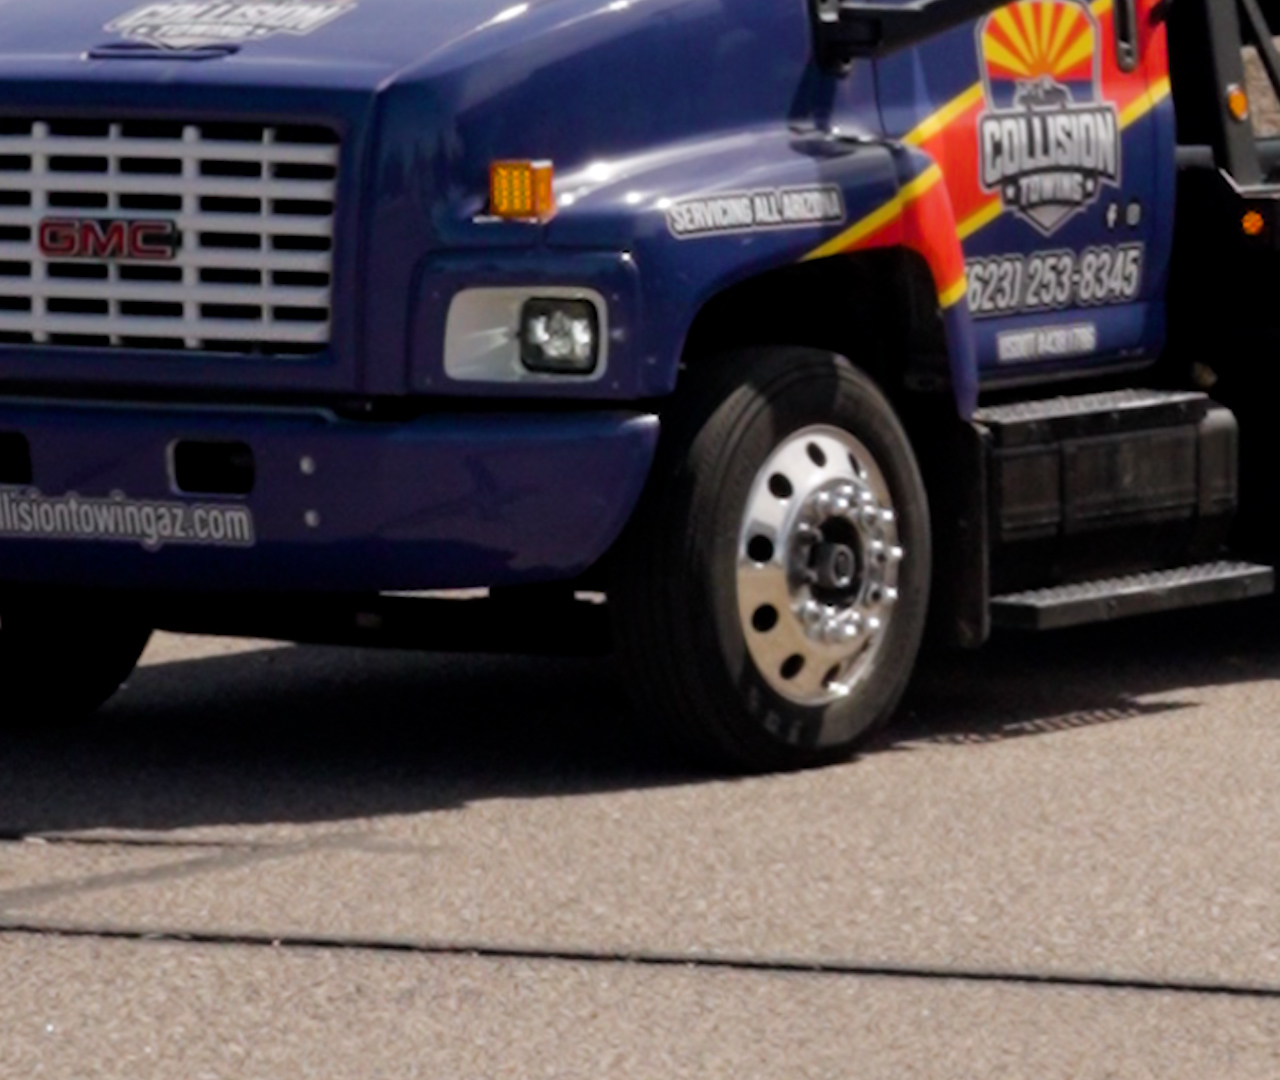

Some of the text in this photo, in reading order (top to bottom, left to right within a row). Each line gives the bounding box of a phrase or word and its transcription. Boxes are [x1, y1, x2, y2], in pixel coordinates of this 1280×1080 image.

[115, 0, 348, 30] COLLISION
[983, 112, 1116, 183] COLLISION
[1018, 172, 1083, 208] TOWING
[672, 196, 753, 233] SERVICING
[752, 191, 783, 225] ALL
[38, 218, 174, 259] GMC
[964, 249, 1140, 313] 623) 253-8345
